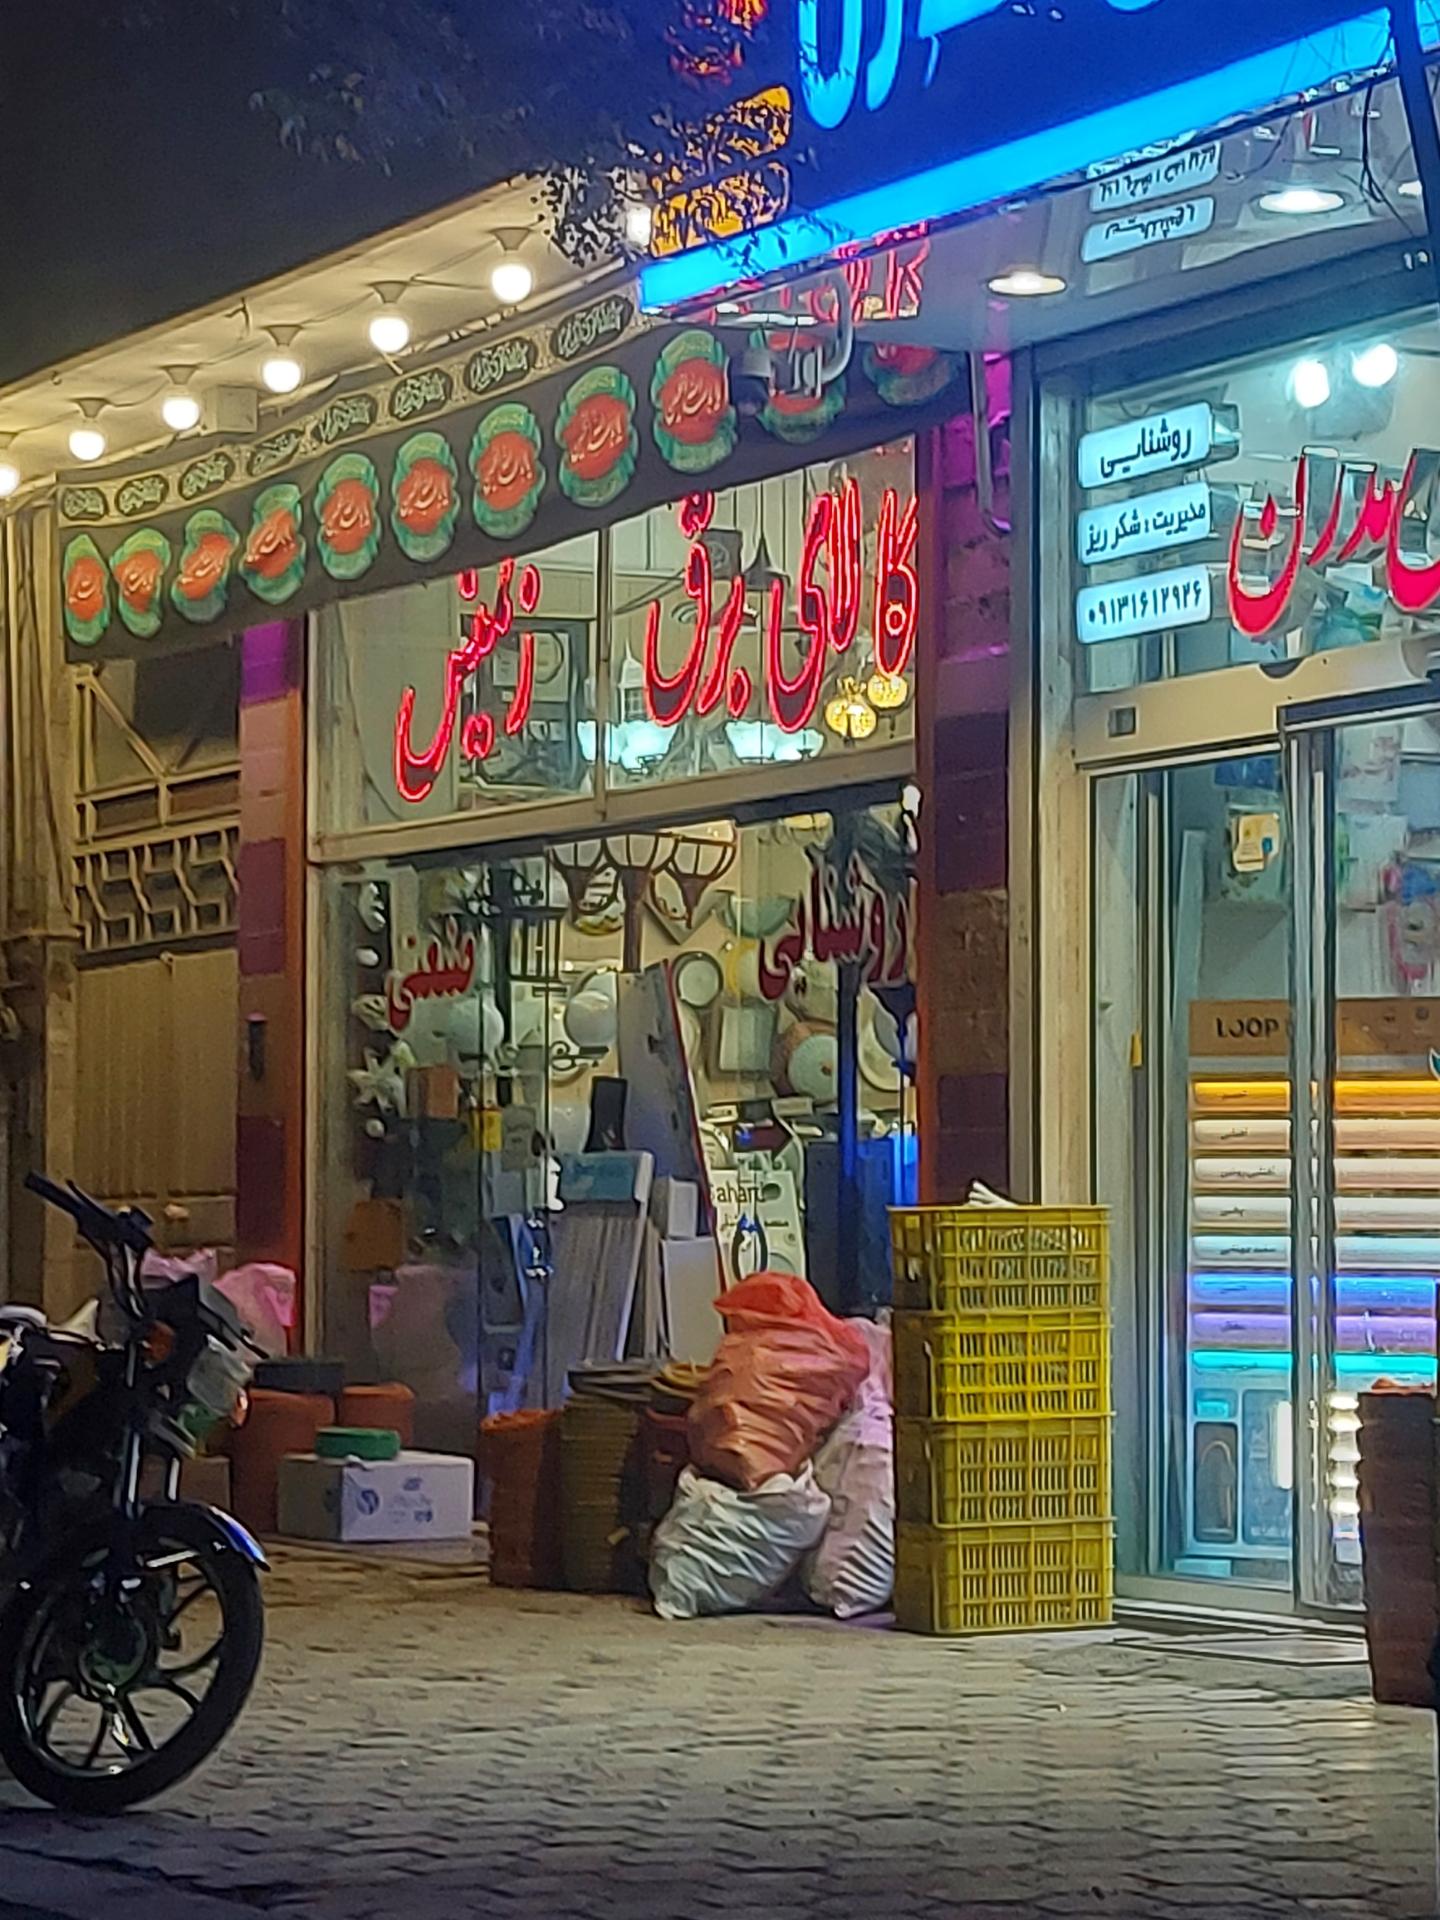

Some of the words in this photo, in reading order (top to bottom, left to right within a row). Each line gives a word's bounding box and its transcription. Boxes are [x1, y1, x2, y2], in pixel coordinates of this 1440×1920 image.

[1100, 417, 1192, 479] روشنایی
[1152, 501, 1207, 535] مدیریت
[643, 489, 750, 728] برق
[767, 476, 921, 734] کالای
[1088, 579, 1203, 626] ۰۹۱۳۱۶۱۲۹۲۶
